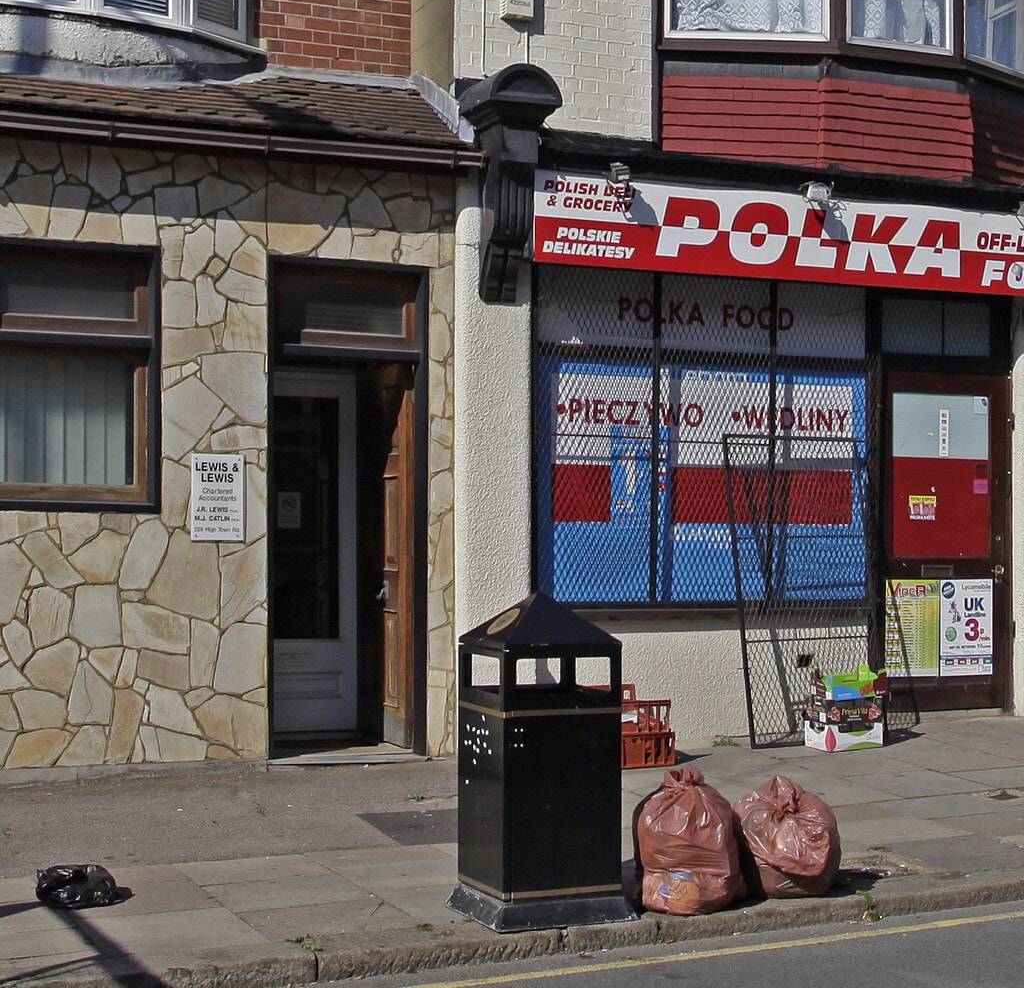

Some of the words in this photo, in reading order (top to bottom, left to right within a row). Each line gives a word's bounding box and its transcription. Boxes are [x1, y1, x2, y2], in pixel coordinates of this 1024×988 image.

[544, 180, 599, 196] POLISH
[547, 195, 557, 207] &
[563, 196, 633, 213] GROCERY
[556, 226, 622, 244] POLSKIE
[654, 195, 961, 278] POLKA
[542, 240, 636, 260] DELIKATESY
[617, 296, 705, 327] POKA
[722, 303, 795, 332] FOOD
[742, 405, 851, 432] WDLINY
[196, 462, 228, 472] LEWIS
[232, 462, 239, 472] &
[201, 473, 234, 483] LEWIS
[198, 494, 237, 502] Accountants
[964, 598, 985, 612] UK
[964, 618, 980, 642] 3
